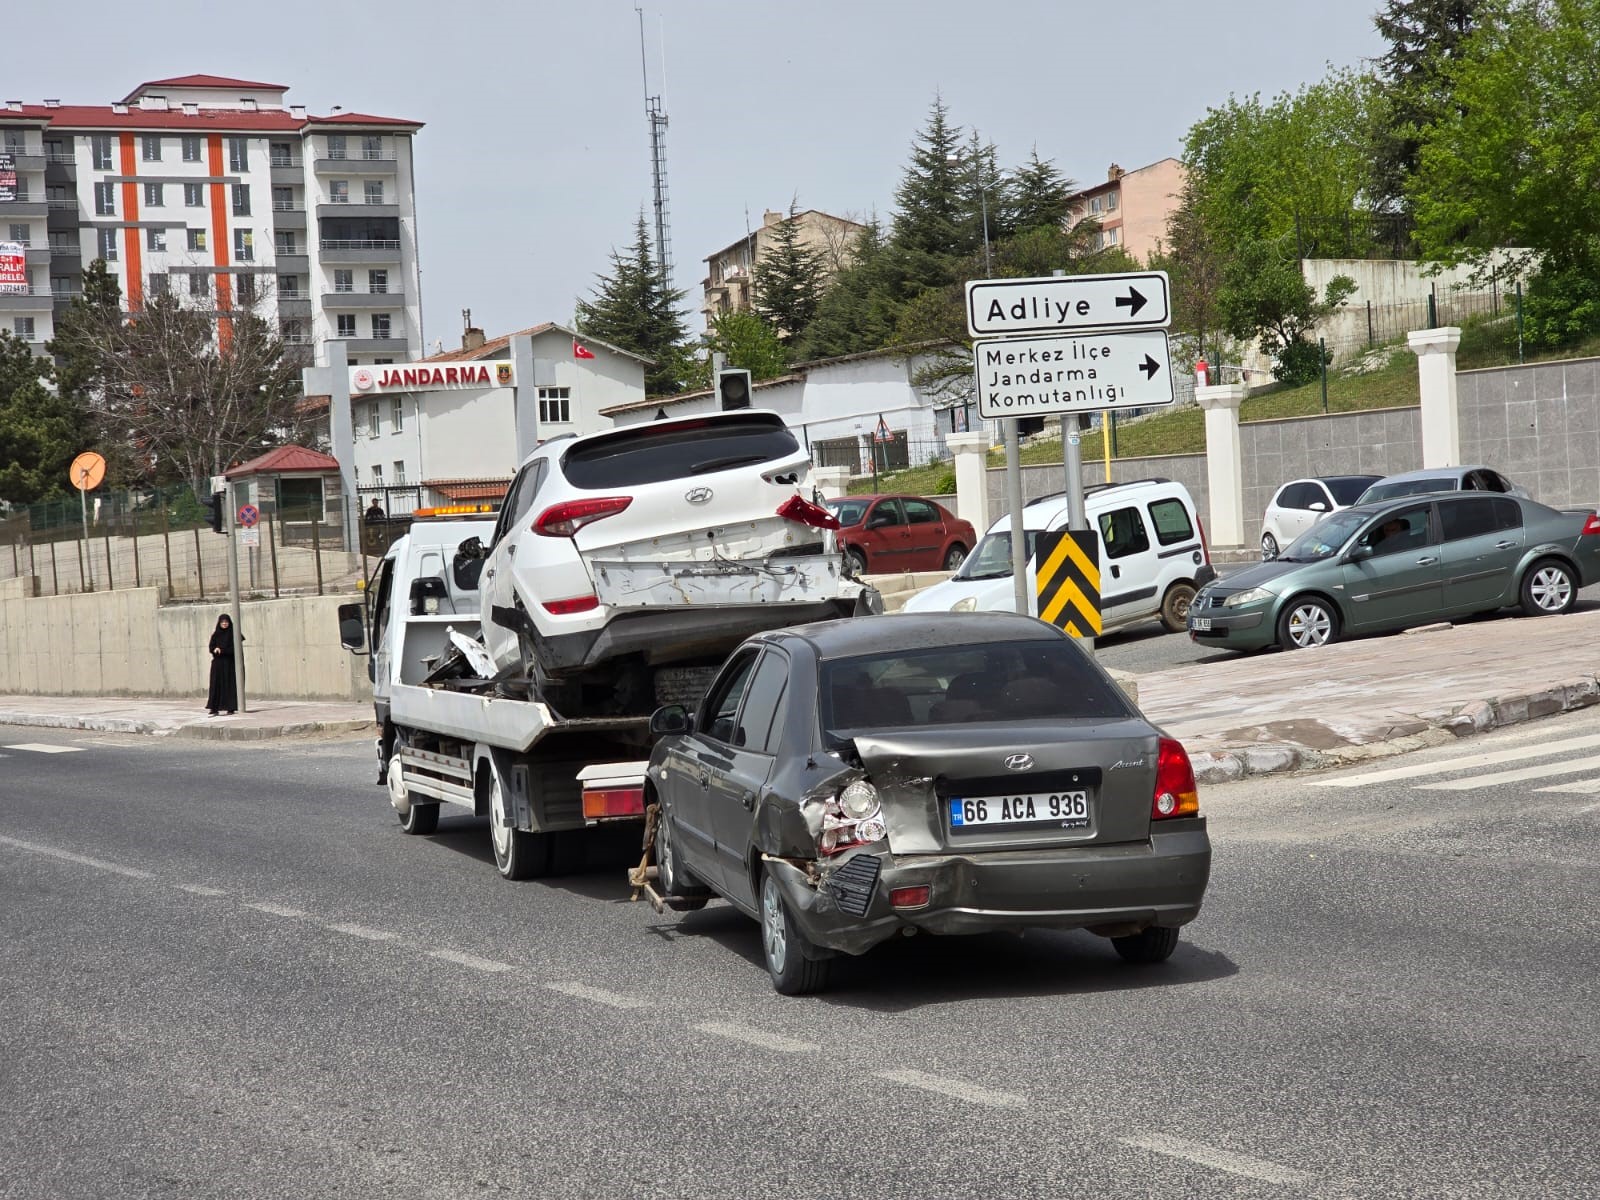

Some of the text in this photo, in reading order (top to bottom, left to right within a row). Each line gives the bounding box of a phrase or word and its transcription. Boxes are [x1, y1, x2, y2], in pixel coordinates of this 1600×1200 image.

[987, 296, 1091, 324] Adliye
[986, 340, 1112, 366] Merkez İlçe
[377, 365, 492, 388] JANDARMA
[989, 367, 1098, 387] Jandarma
[989, 384, 1125, 408] Komutanlığı
[953, 792, 1085, 822] TR 66 ACA 936
